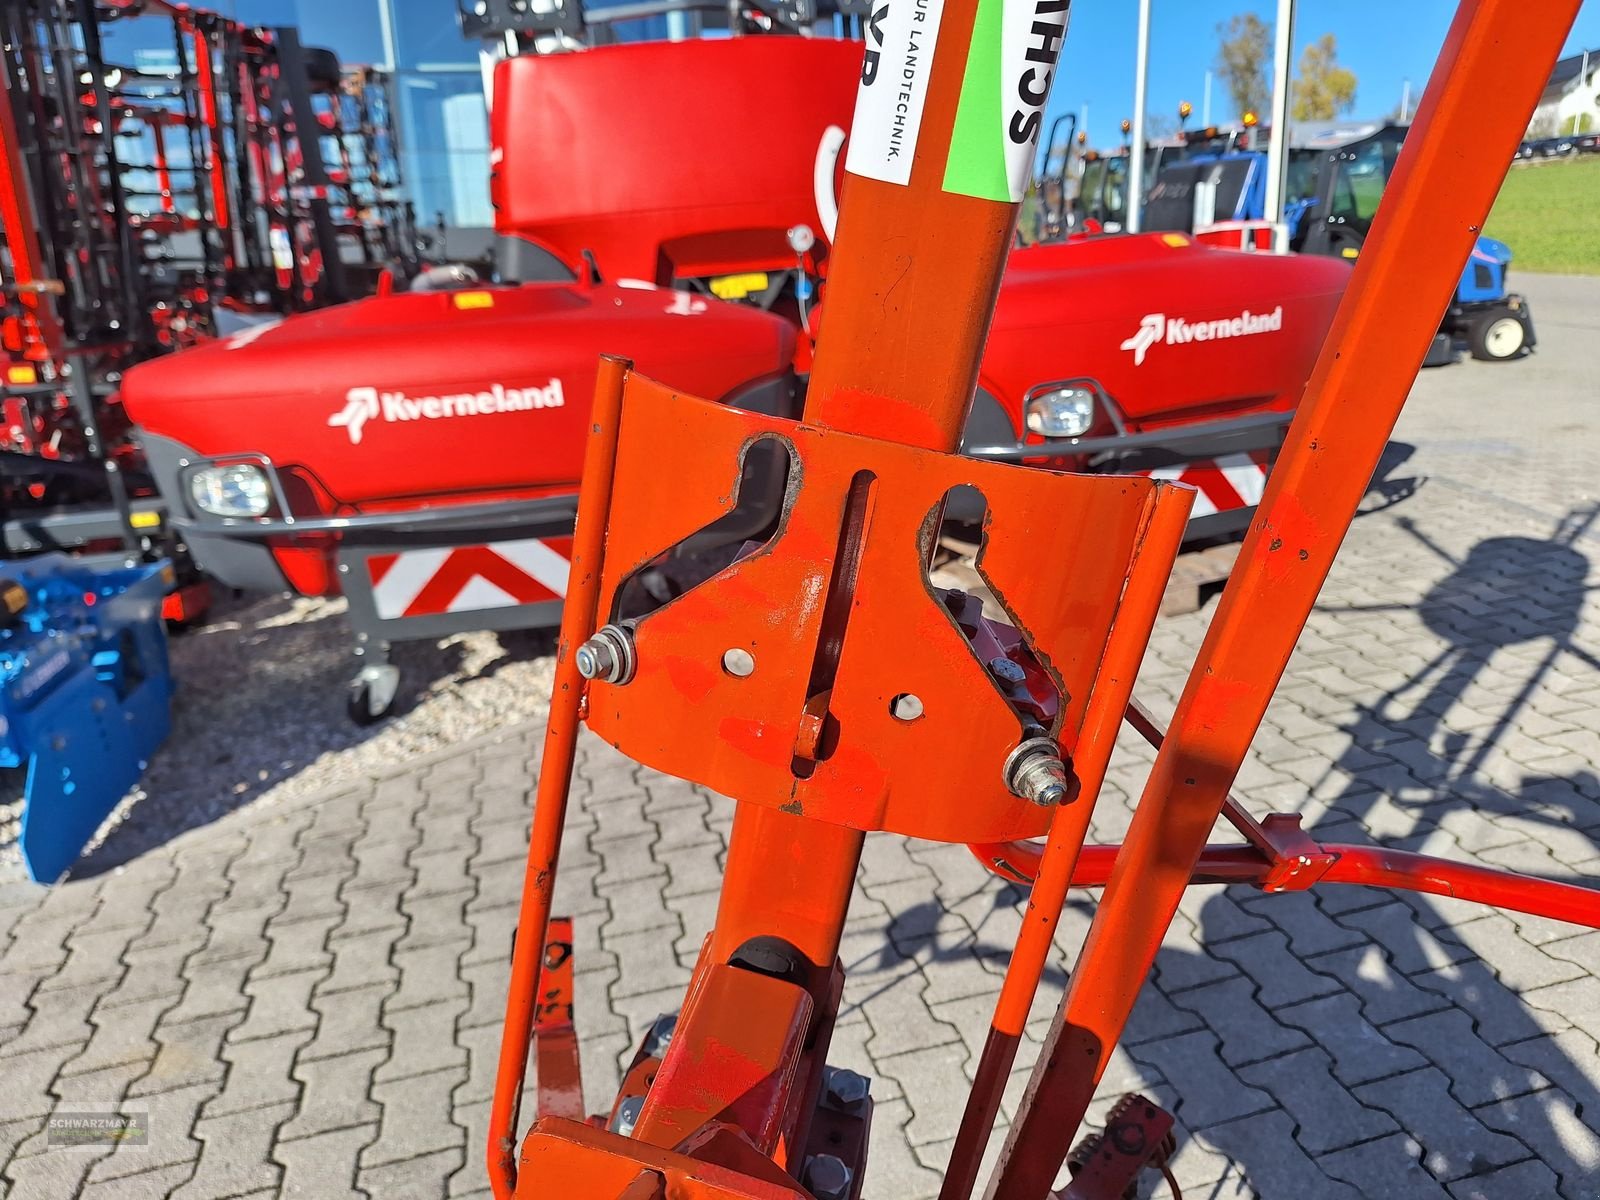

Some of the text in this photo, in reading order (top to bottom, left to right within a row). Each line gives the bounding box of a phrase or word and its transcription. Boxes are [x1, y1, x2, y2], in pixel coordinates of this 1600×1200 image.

[887, 30, 922, 162] LANDTECHNIK.
[1166, 305, 1283, 345] Kverneland
[381, 377, 565, 422] Kverneland
